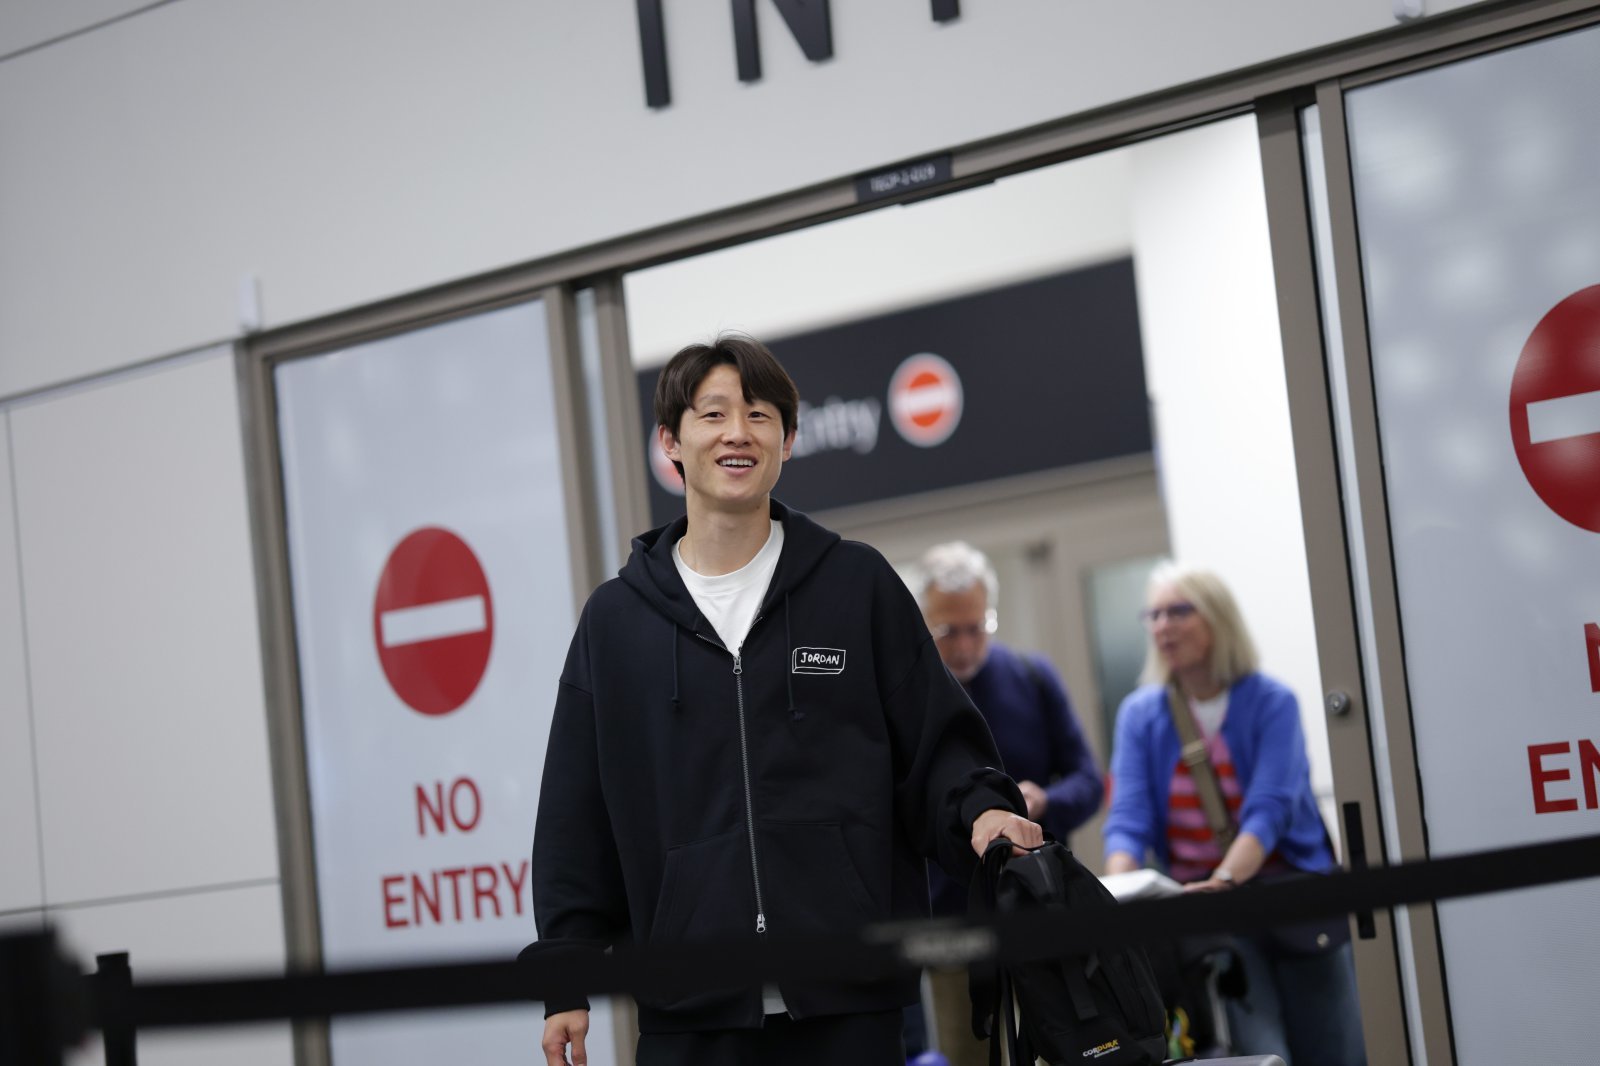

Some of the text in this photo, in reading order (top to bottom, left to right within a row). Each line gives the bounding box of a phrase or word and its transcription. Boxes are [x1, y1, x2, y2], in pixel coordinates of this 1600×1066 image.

[800, 652, 840, 665] JORDAN
[414, 776, 483, 837] NO
[381, 860, 529, 929] ENTRY
